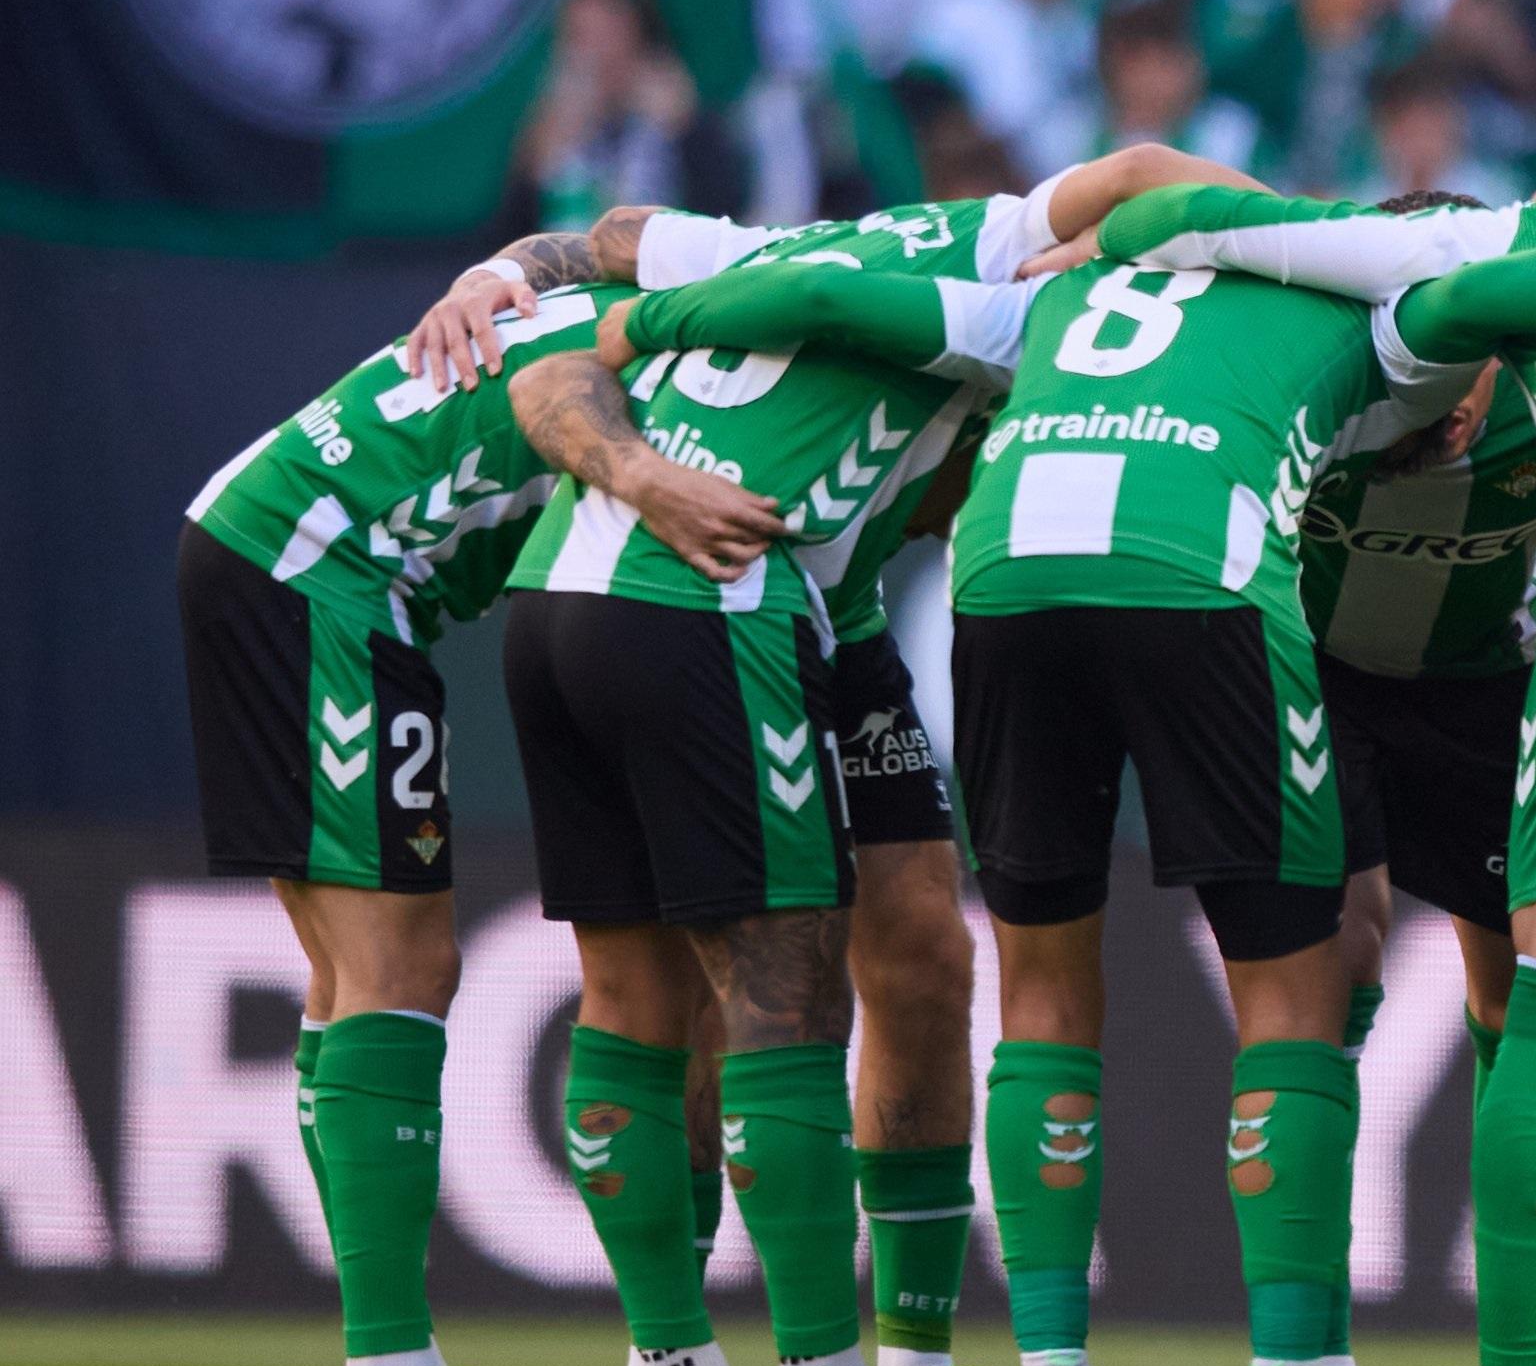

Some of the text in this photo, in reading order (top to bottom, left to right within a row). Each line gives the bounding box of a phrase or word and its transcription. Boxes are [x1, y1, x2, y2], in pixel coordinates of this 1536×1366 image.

[1054, 264, 1217, 378] 8
[1020, 403, 1221, 453] trainline
[389, 717, 452, 809] 2
[841, 748, 941, 778] GLOBA
[881, 727, 928, 755] AUS
